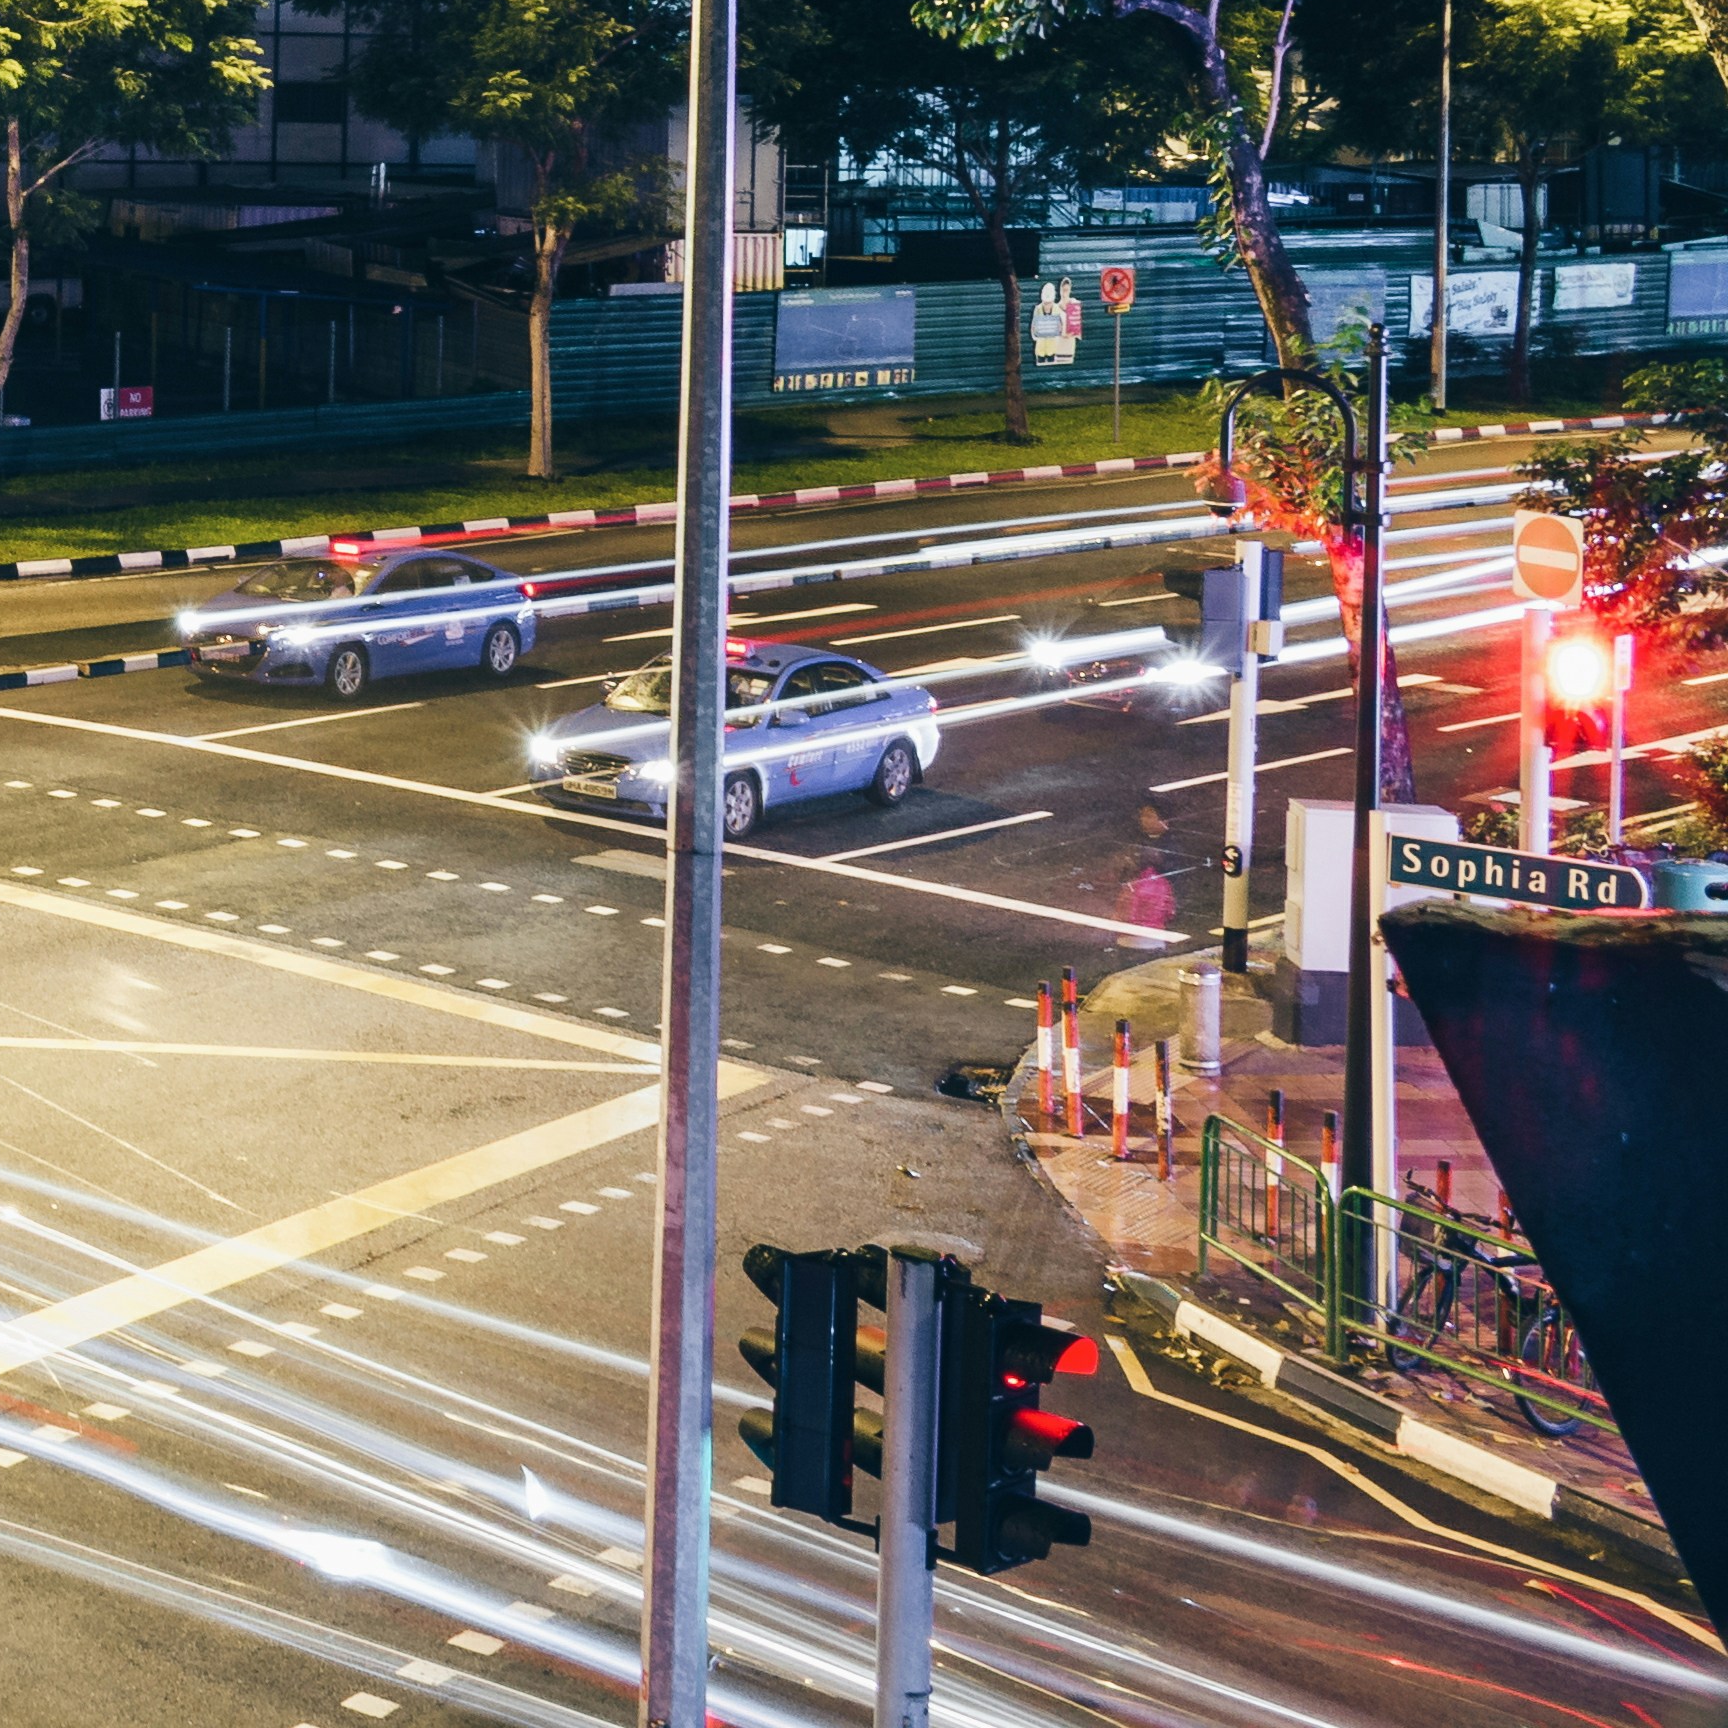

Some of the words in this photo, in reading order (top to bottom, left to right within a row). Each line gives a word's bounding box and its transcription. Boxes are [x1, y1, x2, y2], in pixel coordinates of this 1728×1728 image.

[129, 392, 142, 403] NO
[1401, 843, 1546, 895] Sophia
[1568, 868, 1618, 905] Rd
